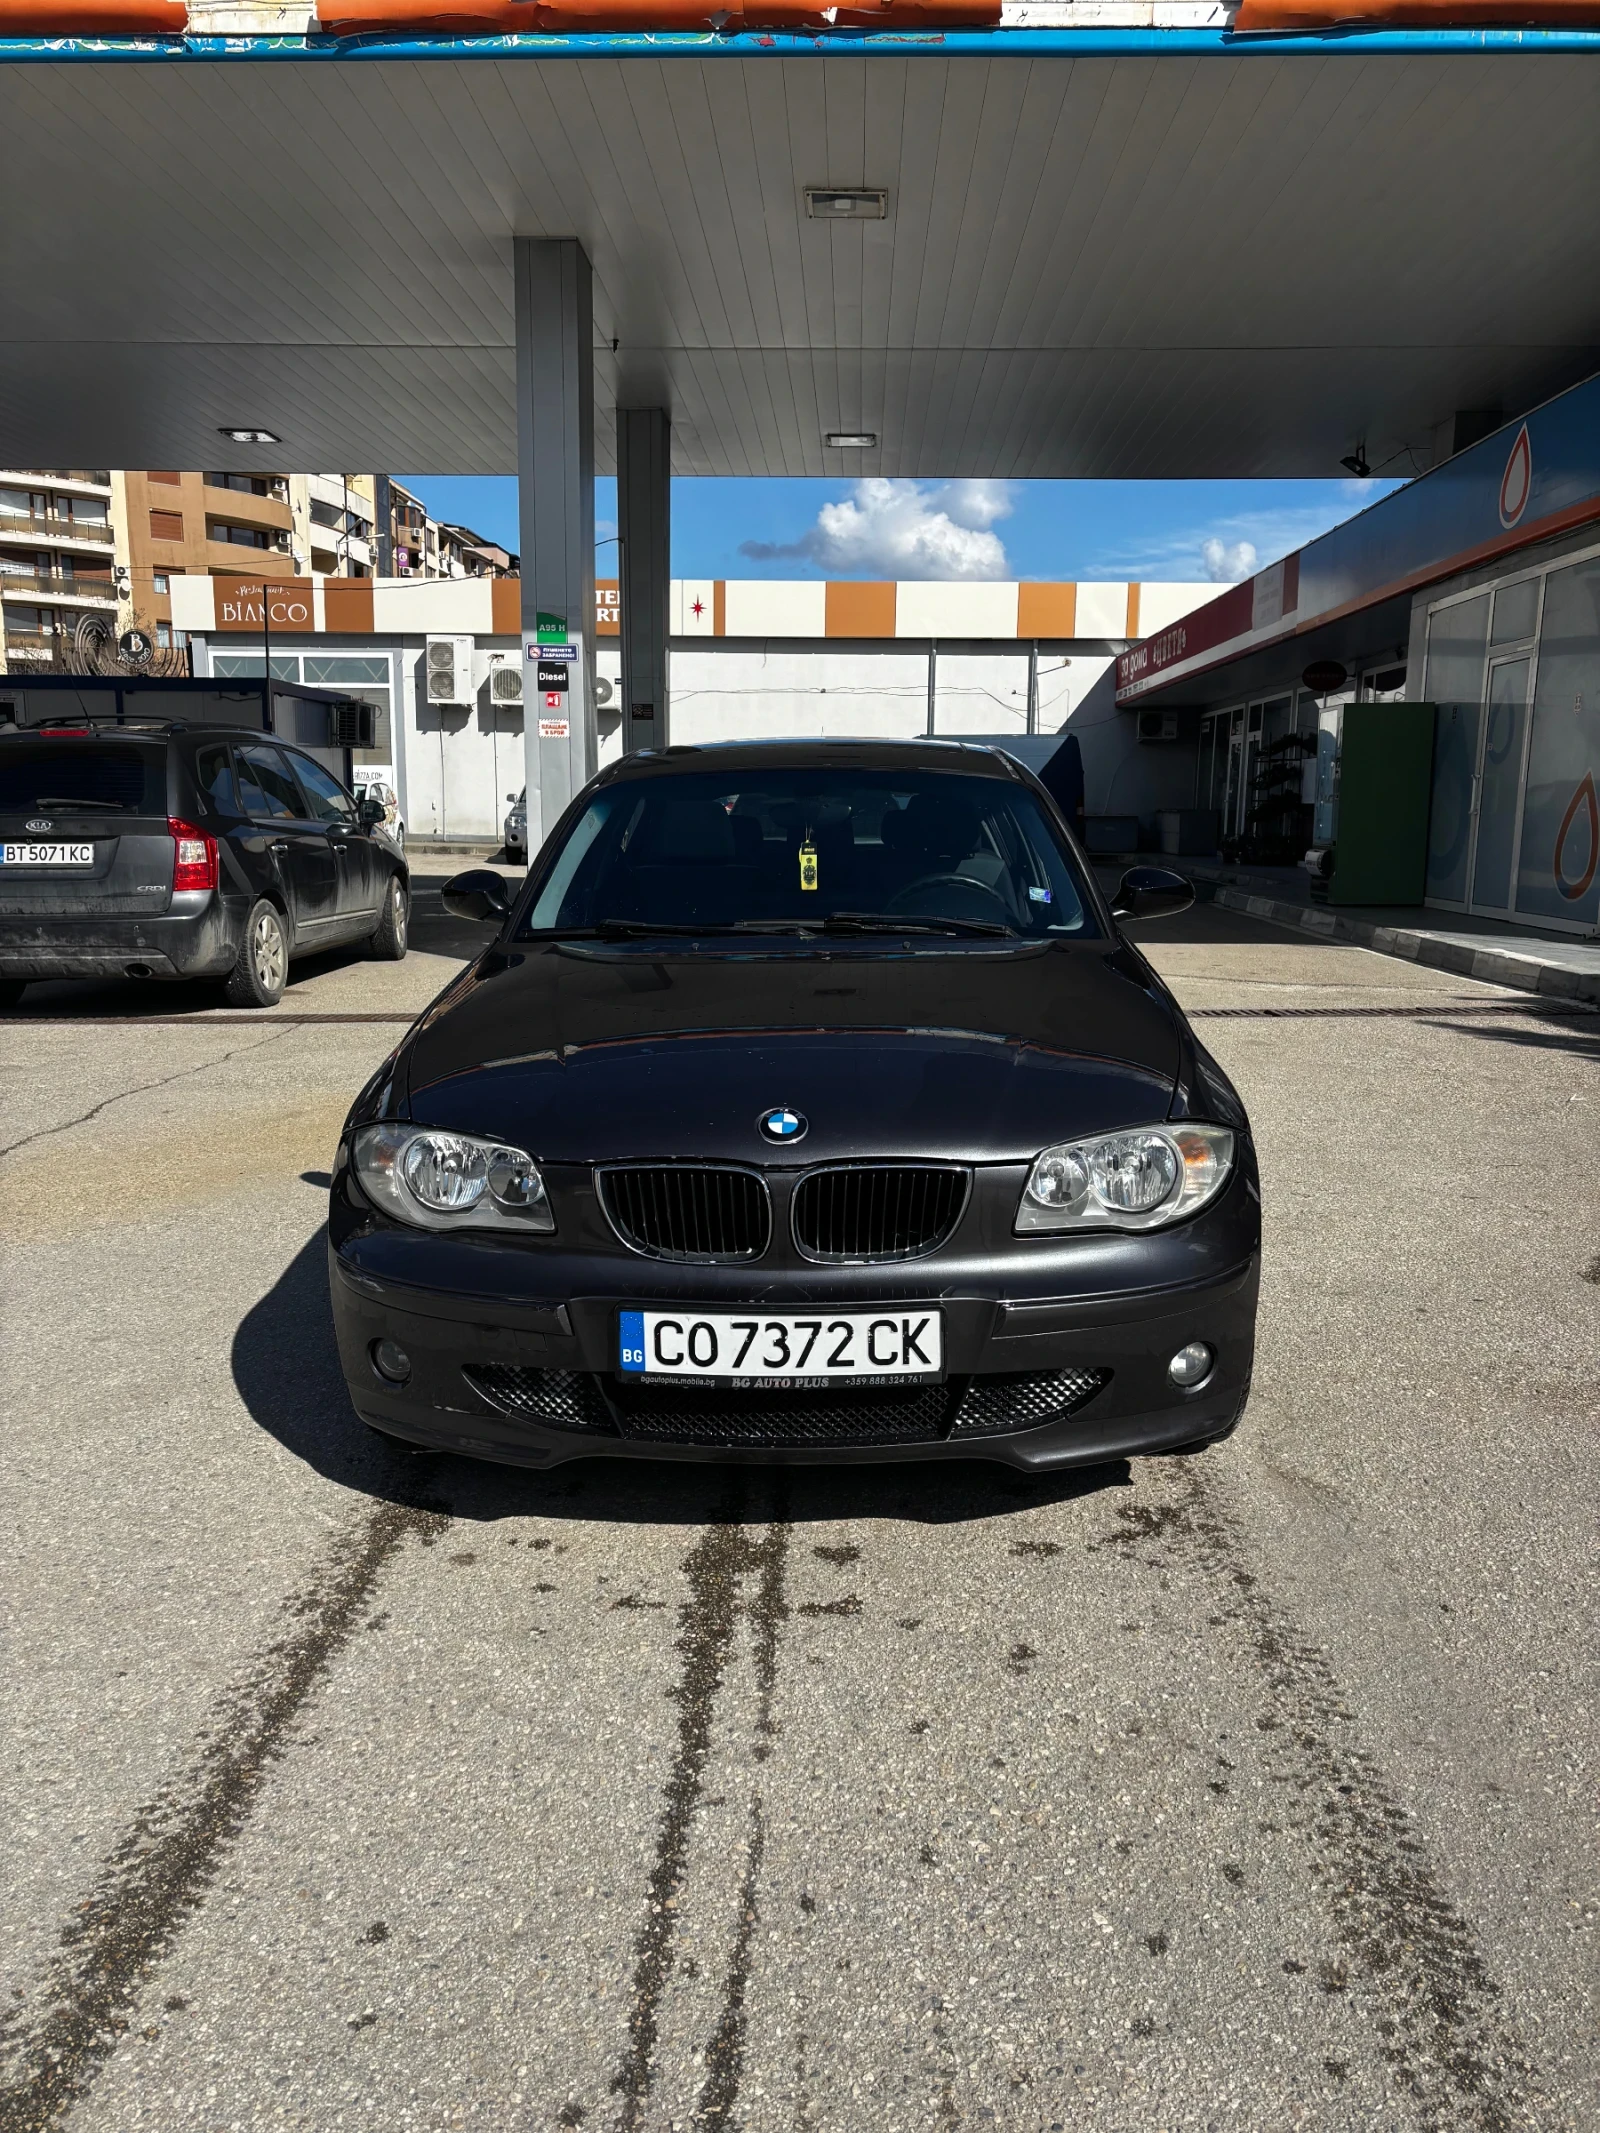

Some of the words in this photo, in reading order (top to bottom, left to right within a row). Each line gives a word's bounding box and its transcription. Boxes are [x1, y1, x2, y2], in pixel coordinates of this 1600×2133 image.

[595, 590, 620, 604] TE
[539, 624, 556, 632] A95
[539, 672, 566, 681] Diesel
[29, 822, 47, 830] KIA
[6, 846, 27, 862] BT
[28, 846, 66, 862] 5071
[69, 846, 91, 862] KC
[654, 1319, 719, 1369] CO
[730, 1321, 856, 1369] 7372
[867, 1318, 932, 1367] CK
[622, 1349, 643, 1364] BG
[731, 1377, 751, 1388] BG
[753, 1377, 791, 1389] AUTO
[794, 1377, 830, 1388] PLUS
[844, 1377, 867, 1386] +359
[869, 1376, 886, 1385] 888
[888, 1375, 905, 1384] 324
[907, 1375, 923, 1383] 761
